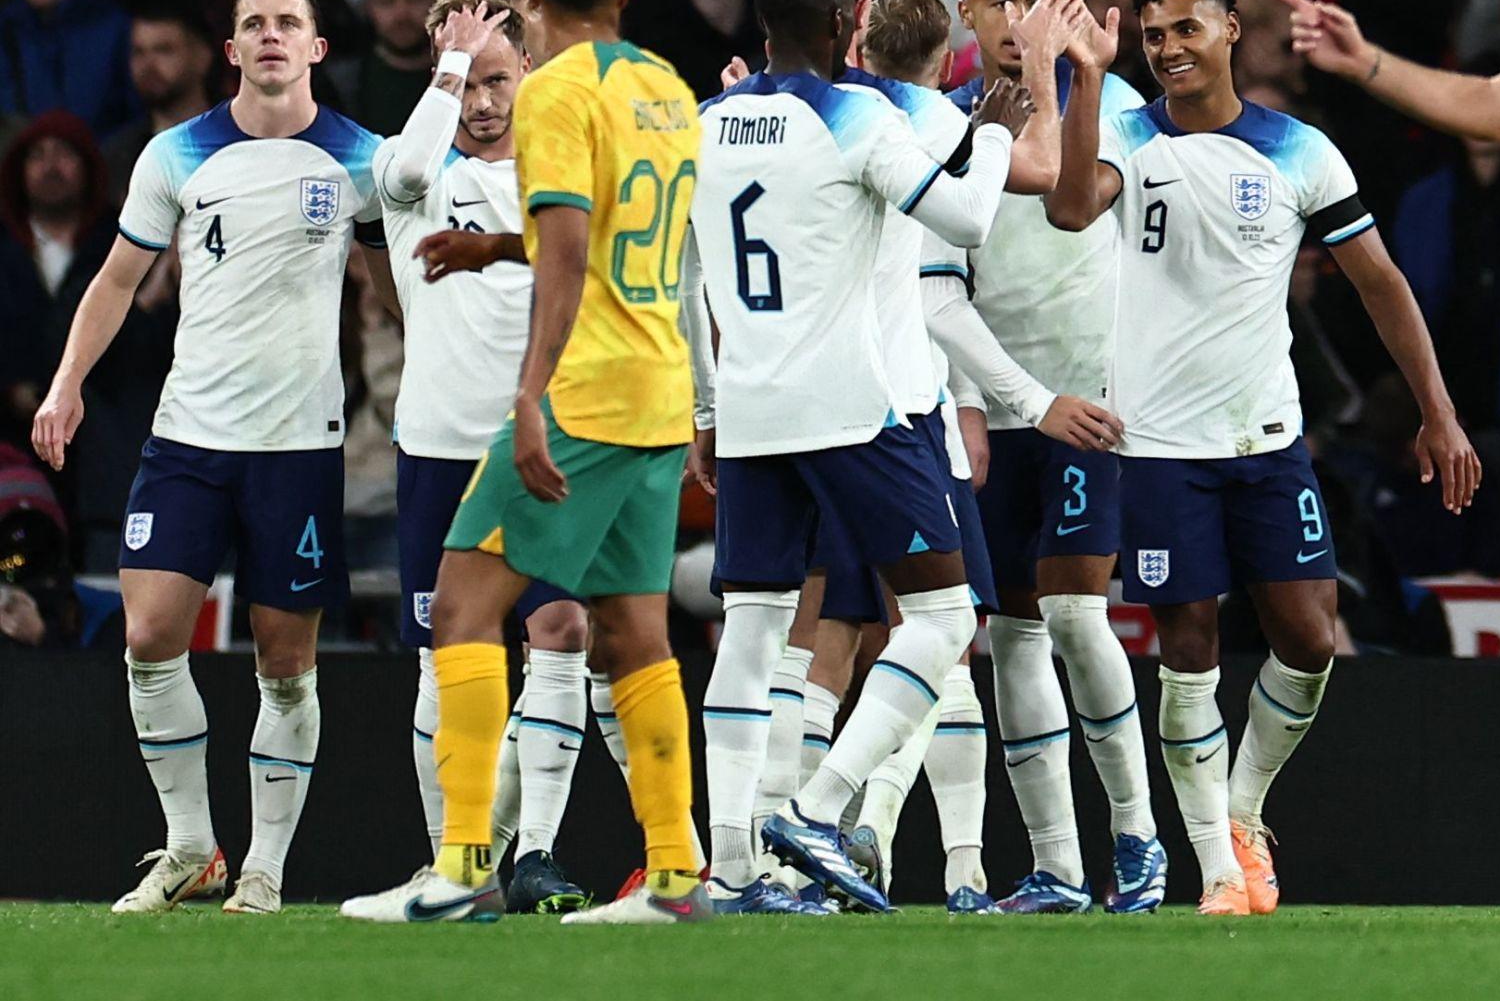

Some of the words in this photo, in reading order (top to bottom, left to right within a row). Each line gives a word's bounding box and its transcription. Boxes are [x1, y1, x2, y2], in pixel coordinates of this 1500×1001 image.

[205, 214, 226, 263] 4
[611, 159, 697, 303] 20
[730, 179, 783, 312] 6
[1141, 199, 1168, 254] 9
[1063, 464, 1087, 517] 3
[1297, 487, 1323, 542] 9
[296, 514, 324, 568] 4
